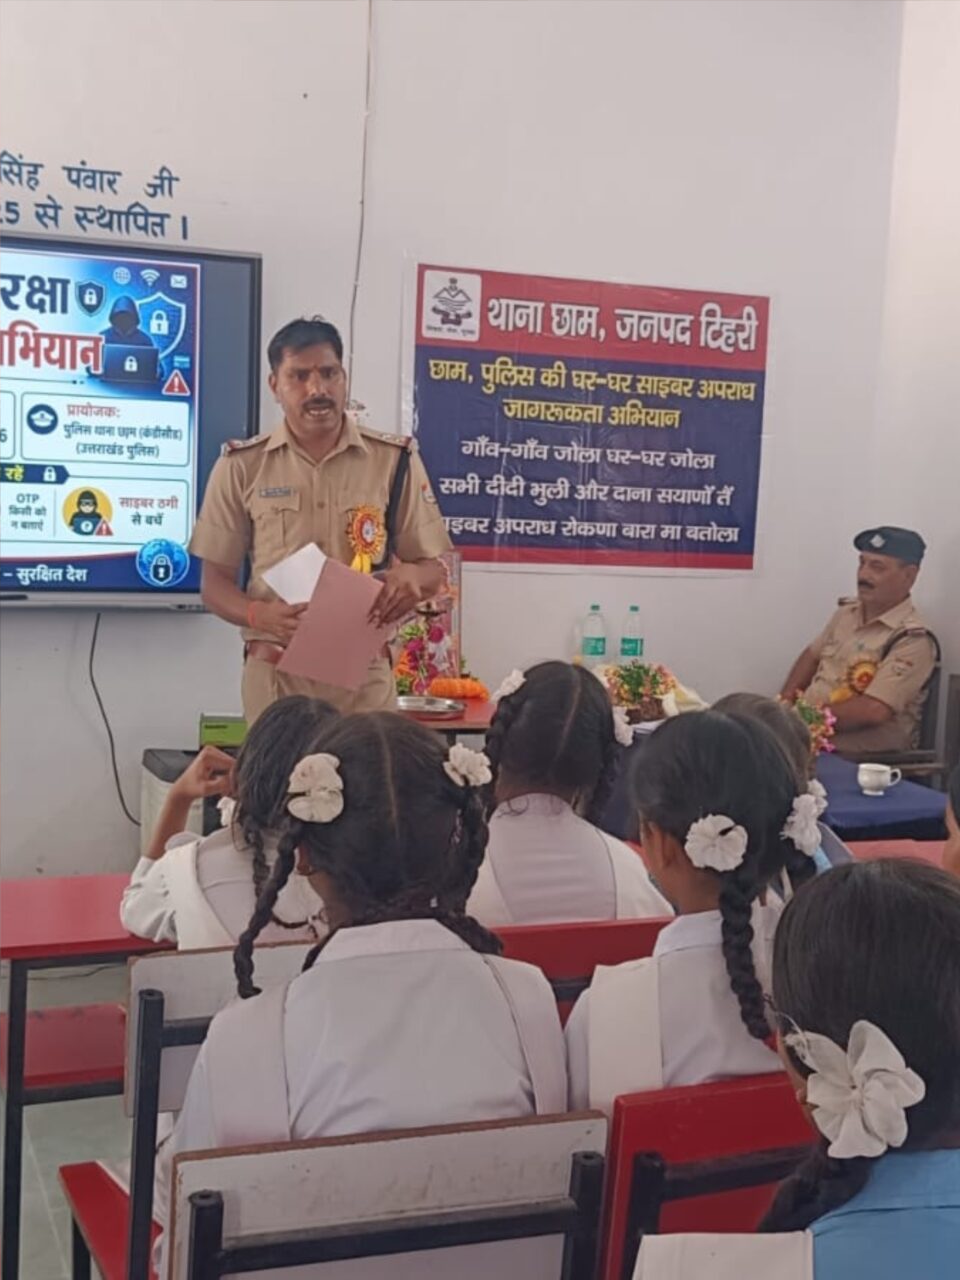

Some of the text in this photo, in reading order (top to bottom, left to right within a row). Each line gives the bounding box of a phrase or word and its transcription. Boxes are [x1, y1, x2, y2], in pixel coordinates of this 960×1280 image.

[62, 160, 122, 195] पंवार
[144, 166, 180, 198] जी
[34, 195, 62, 229] से
[74, 201, 171, 237] स्थापित
[0, 273, 71, 314] रक्षा
[487, 298, 759, 353] थाना छाम, जनपद टिहरी
[0, 320, 103, 372] भियान
[429, 358, 473, 384] छाम,
[480, 356, 536, 394] पुलिस
[540, 360, 566, 389] की
[636, 373, 694, 399] साइबर
[697, 378, 756, 401] अपराध
[503, 398, 681, 429] जागरूकता अभियान
[554, 441, 601, 463] जोला
[670, 448, 716, 469] जोला
[16, 493, 40, 504] OTP
[440, 472, 479, 495] सभी
[485, 473, 525, 497] दीदी
[529, 477, 569, 506] भुली
[574, 477, 609, 501] और
[612, 484, 651, 503] दाना
[494, 516, 556, 537] अपराध
[562, 514, 618, 538] रोकणा
[661, 523, 684, 540] मा
[16, 564, 63, 585] सुरक्षित
[67, 565, 88, 582] देश
